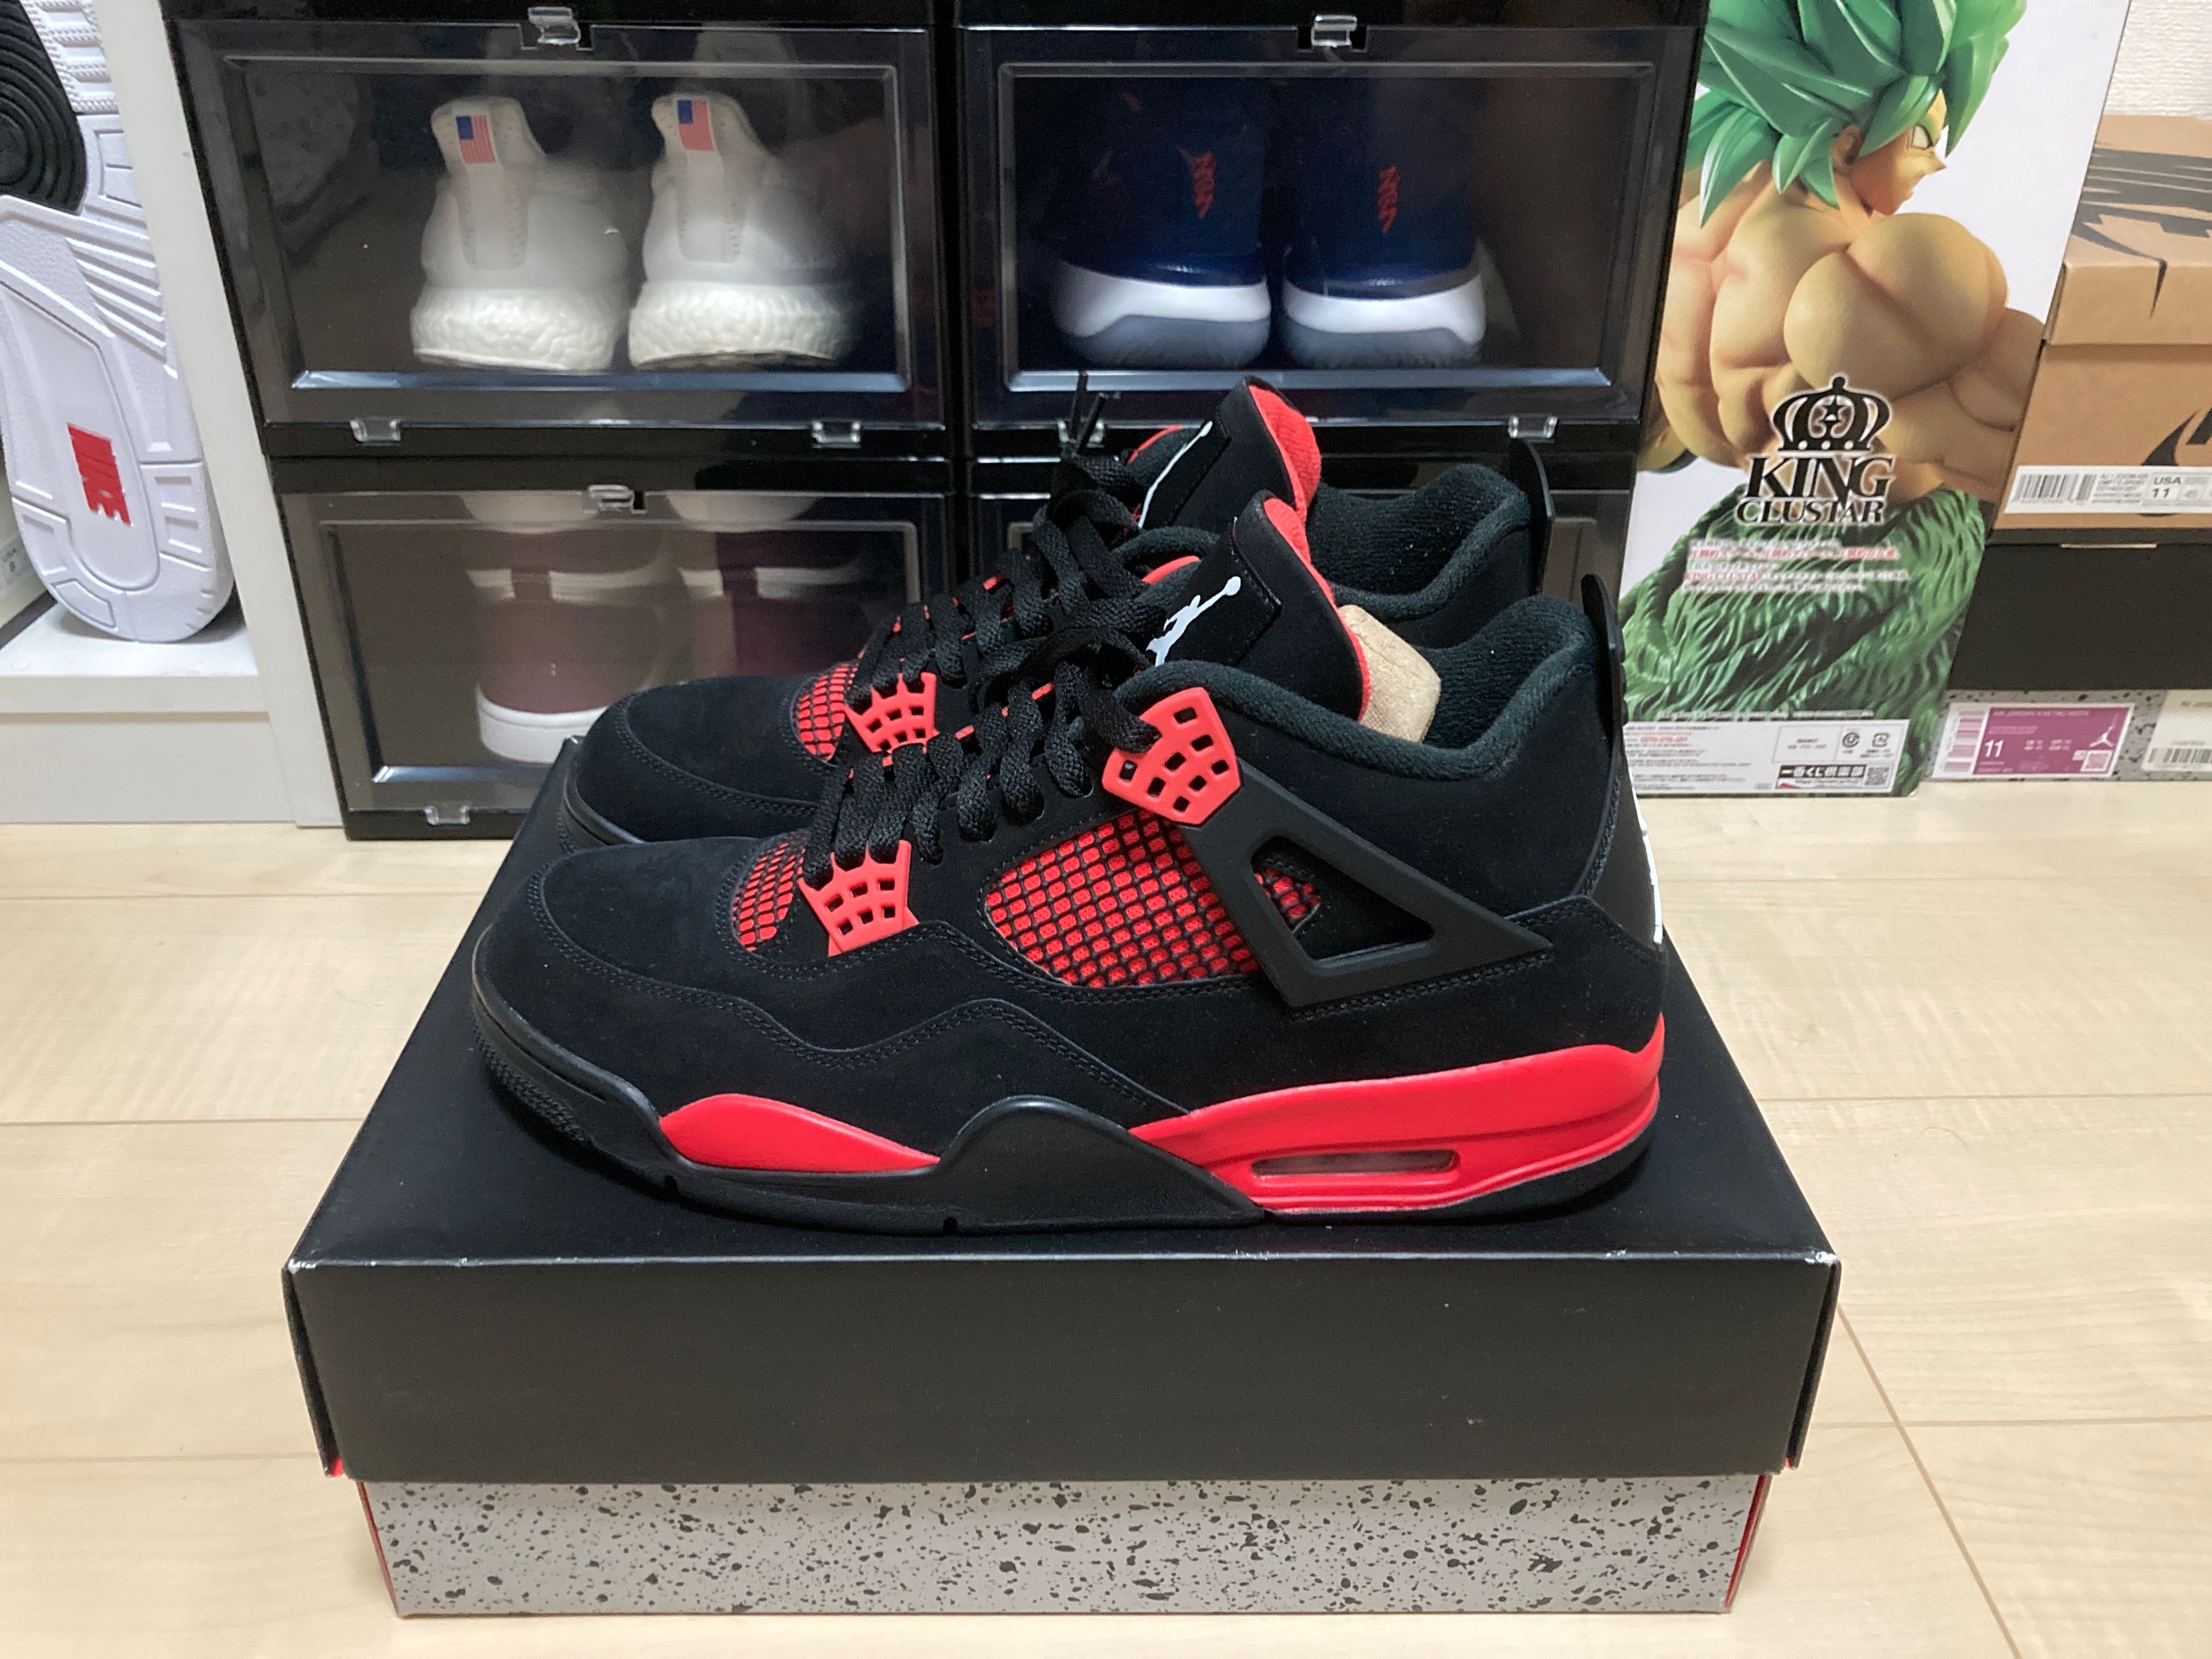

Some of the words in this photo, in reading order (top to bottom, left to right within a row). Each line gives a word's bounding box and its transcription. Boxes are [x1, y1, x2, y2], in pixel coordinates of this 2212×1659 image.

[1746, 457, 1894, 501] KING
[2154, 476, 2181, 484] USA
[2152, 488, 2170, 498] 11
[1736, 500, 1885, 522] CLUSTAR
[1984, 740, 2004, 758] 11
